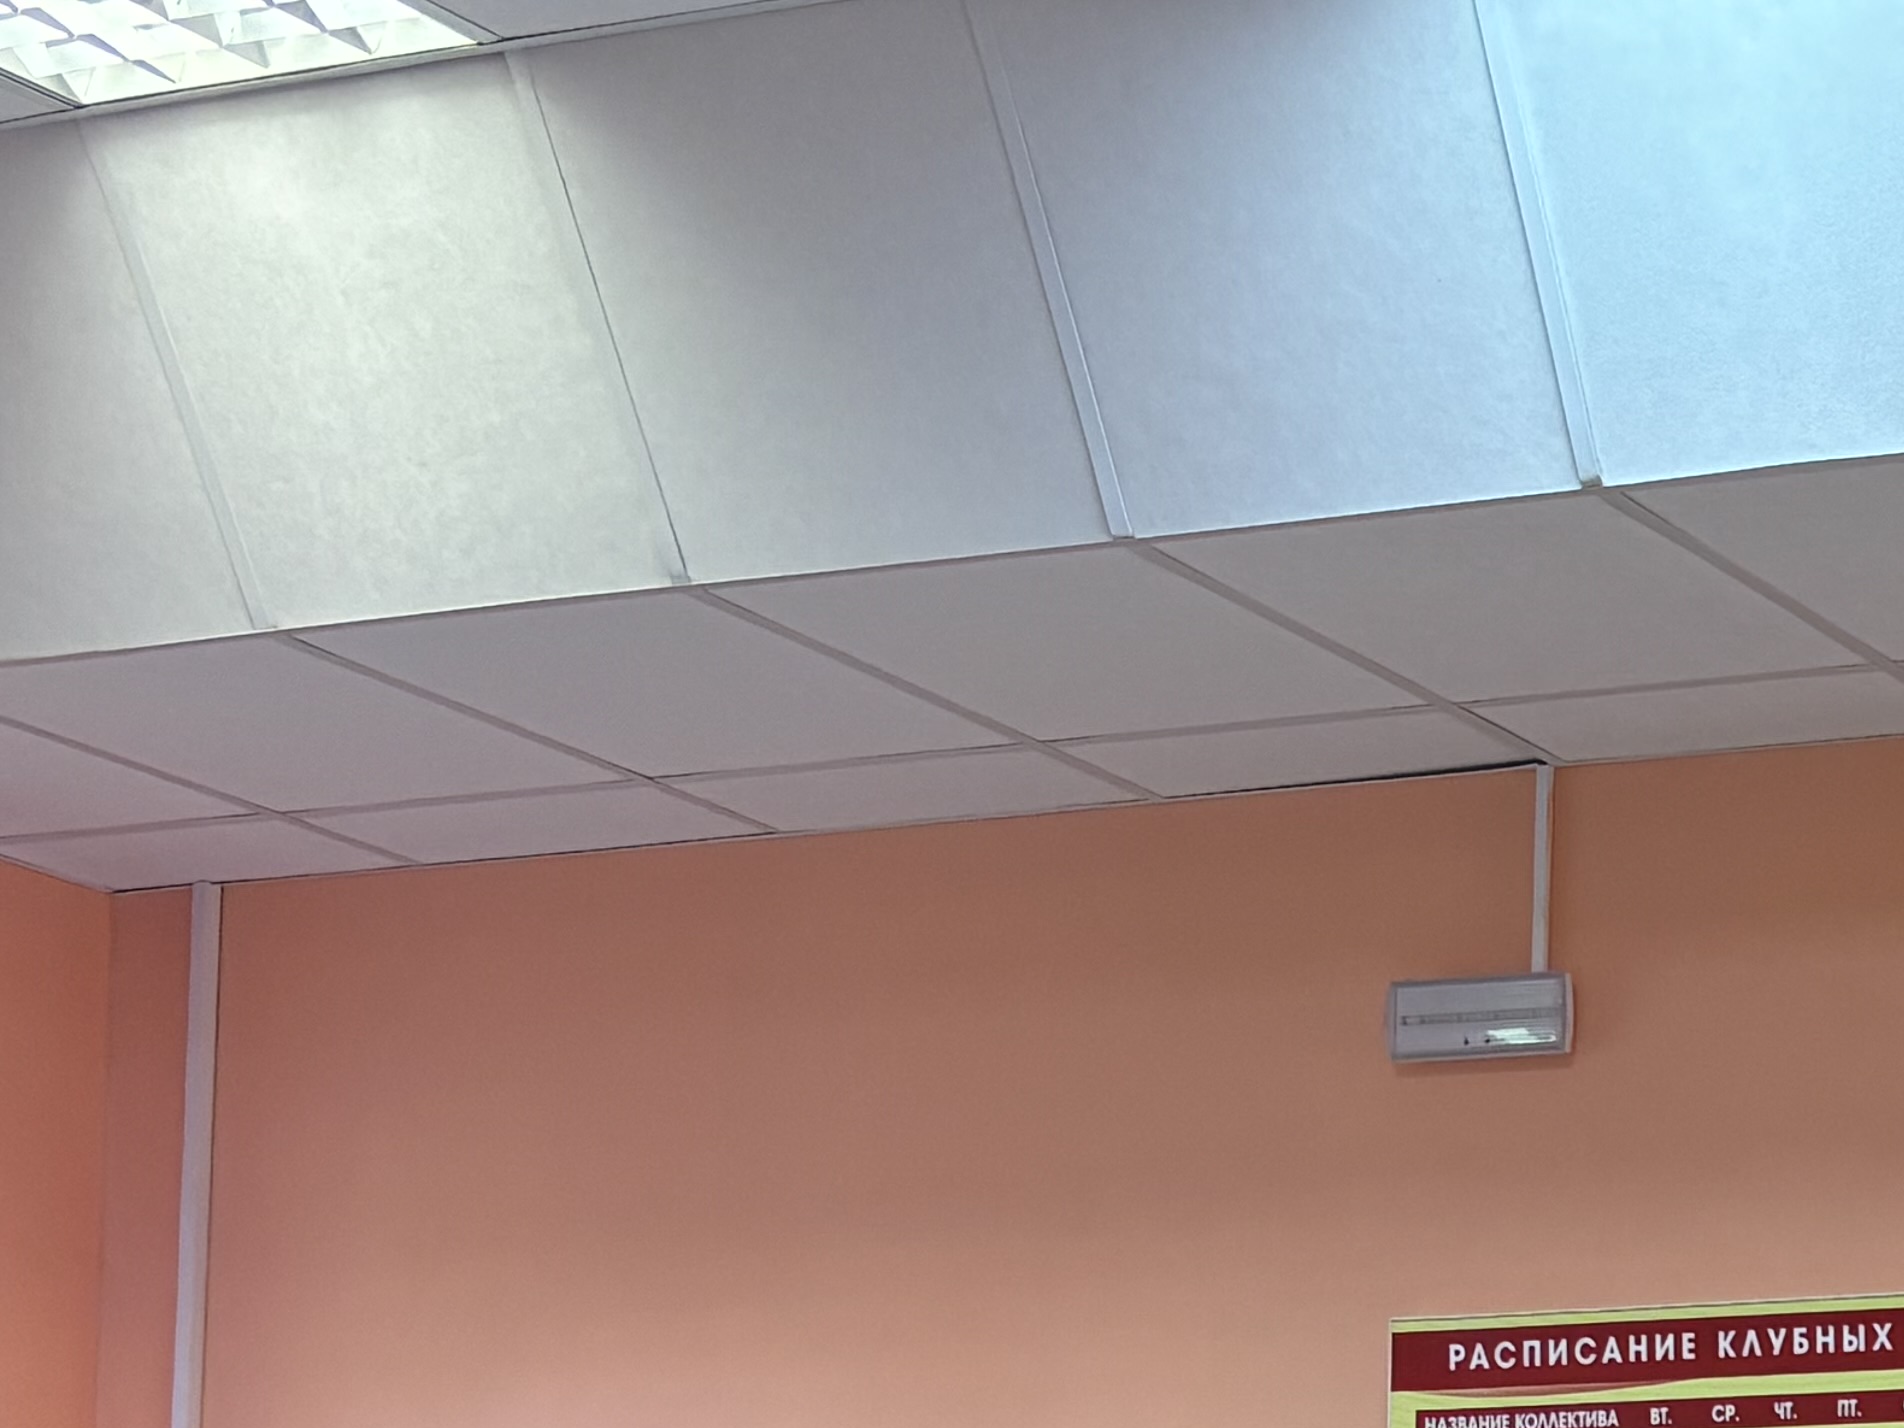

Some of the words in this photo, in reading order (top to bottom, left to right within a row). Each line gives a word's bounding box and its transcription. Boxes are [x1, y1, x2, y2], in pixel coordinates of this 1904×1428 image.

[1449, 1332, 1697, 1372] РАСПИСАНИЕ
[1717, 1322, 1894, 1358] КЛУБНЫХ
[1650, 1408, 1672, 1426] ВТ.
[1712, 1405, 1740, 1423] СР.
[1774, 1402, 1798, 1420] ЧТ.
[1837, 1400, 1862, 1418] ПТ.
